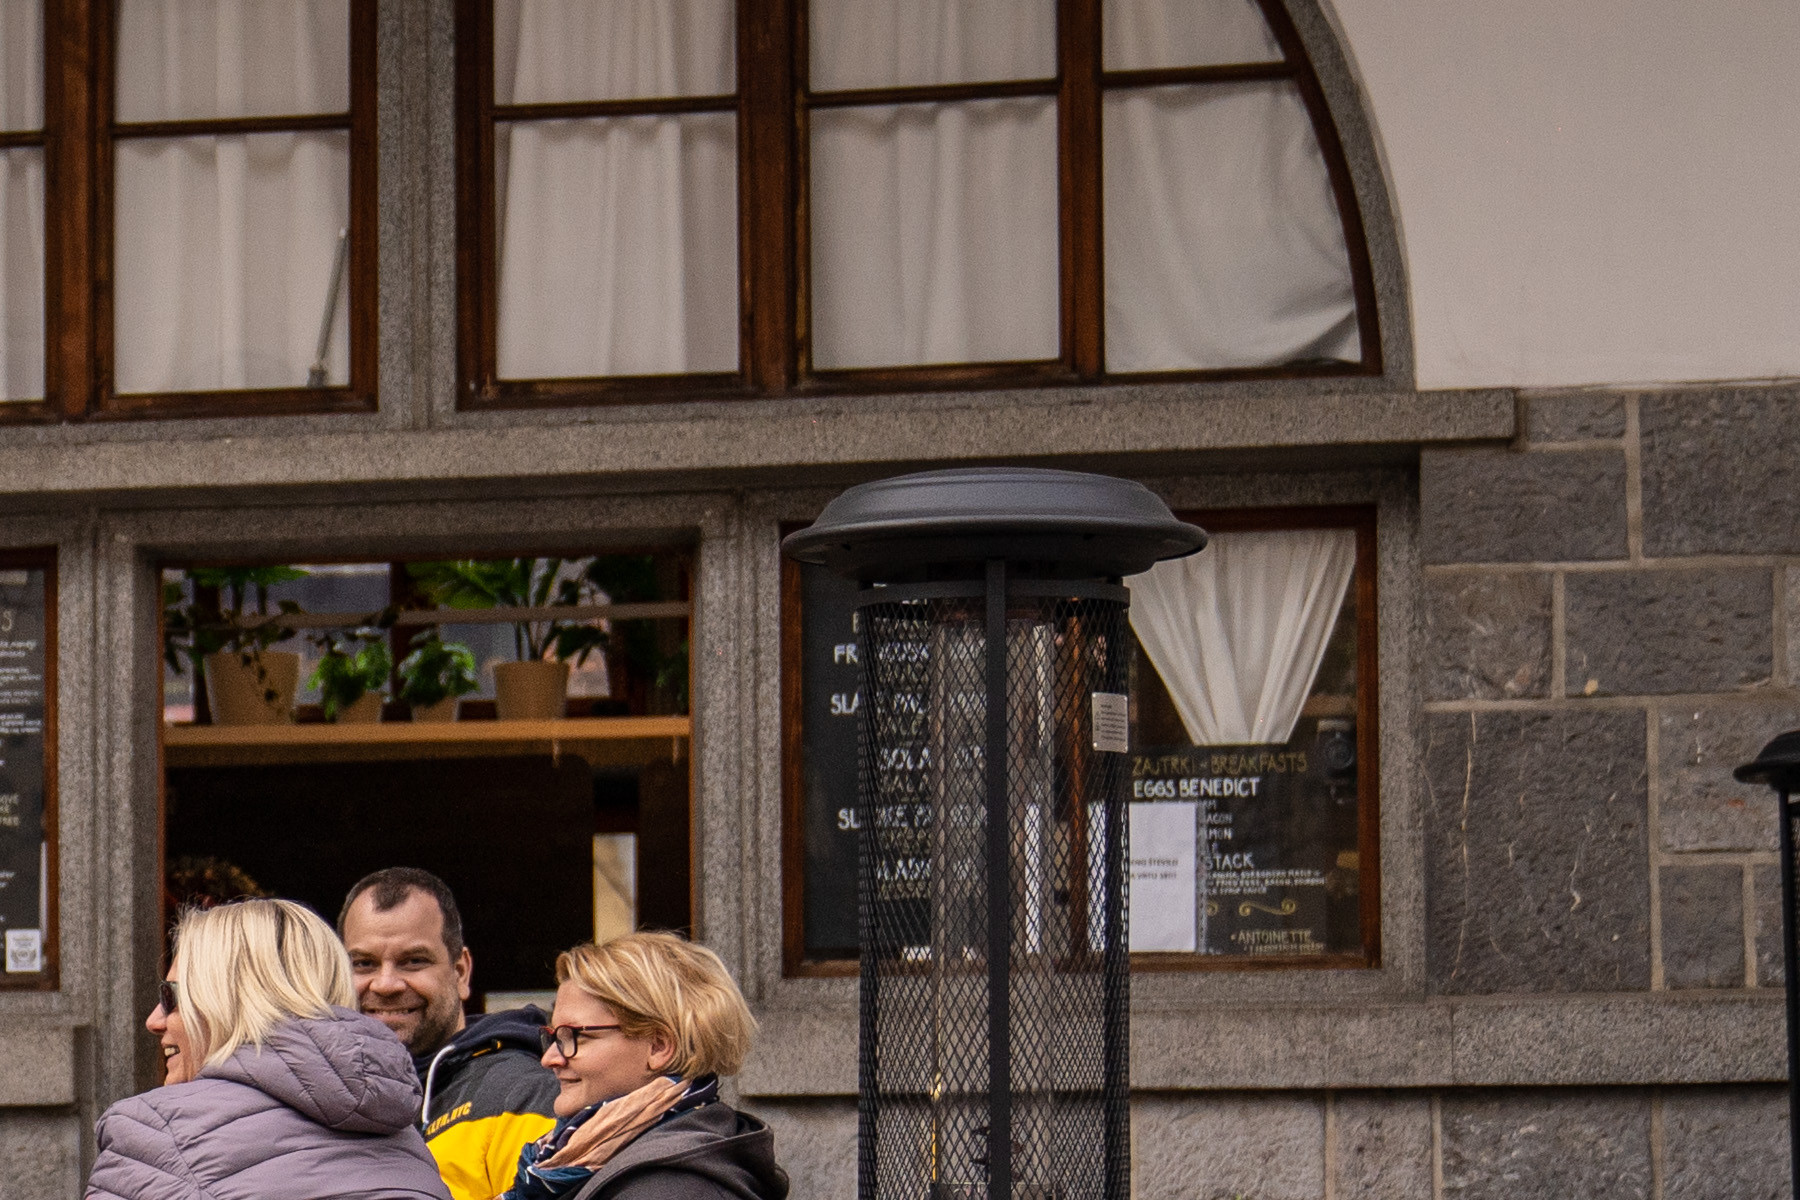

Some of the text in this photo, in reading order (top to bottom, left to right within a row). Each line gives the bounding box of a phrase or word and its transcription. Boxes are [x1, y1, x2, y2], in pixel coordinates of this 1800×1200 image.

[1210, 752, 1308, 774] BREAKFASTS
[1133, 775, 1261, 798] EGGS BENEDICT
[1238, 928, 1312, 945] ANTOINETTE
